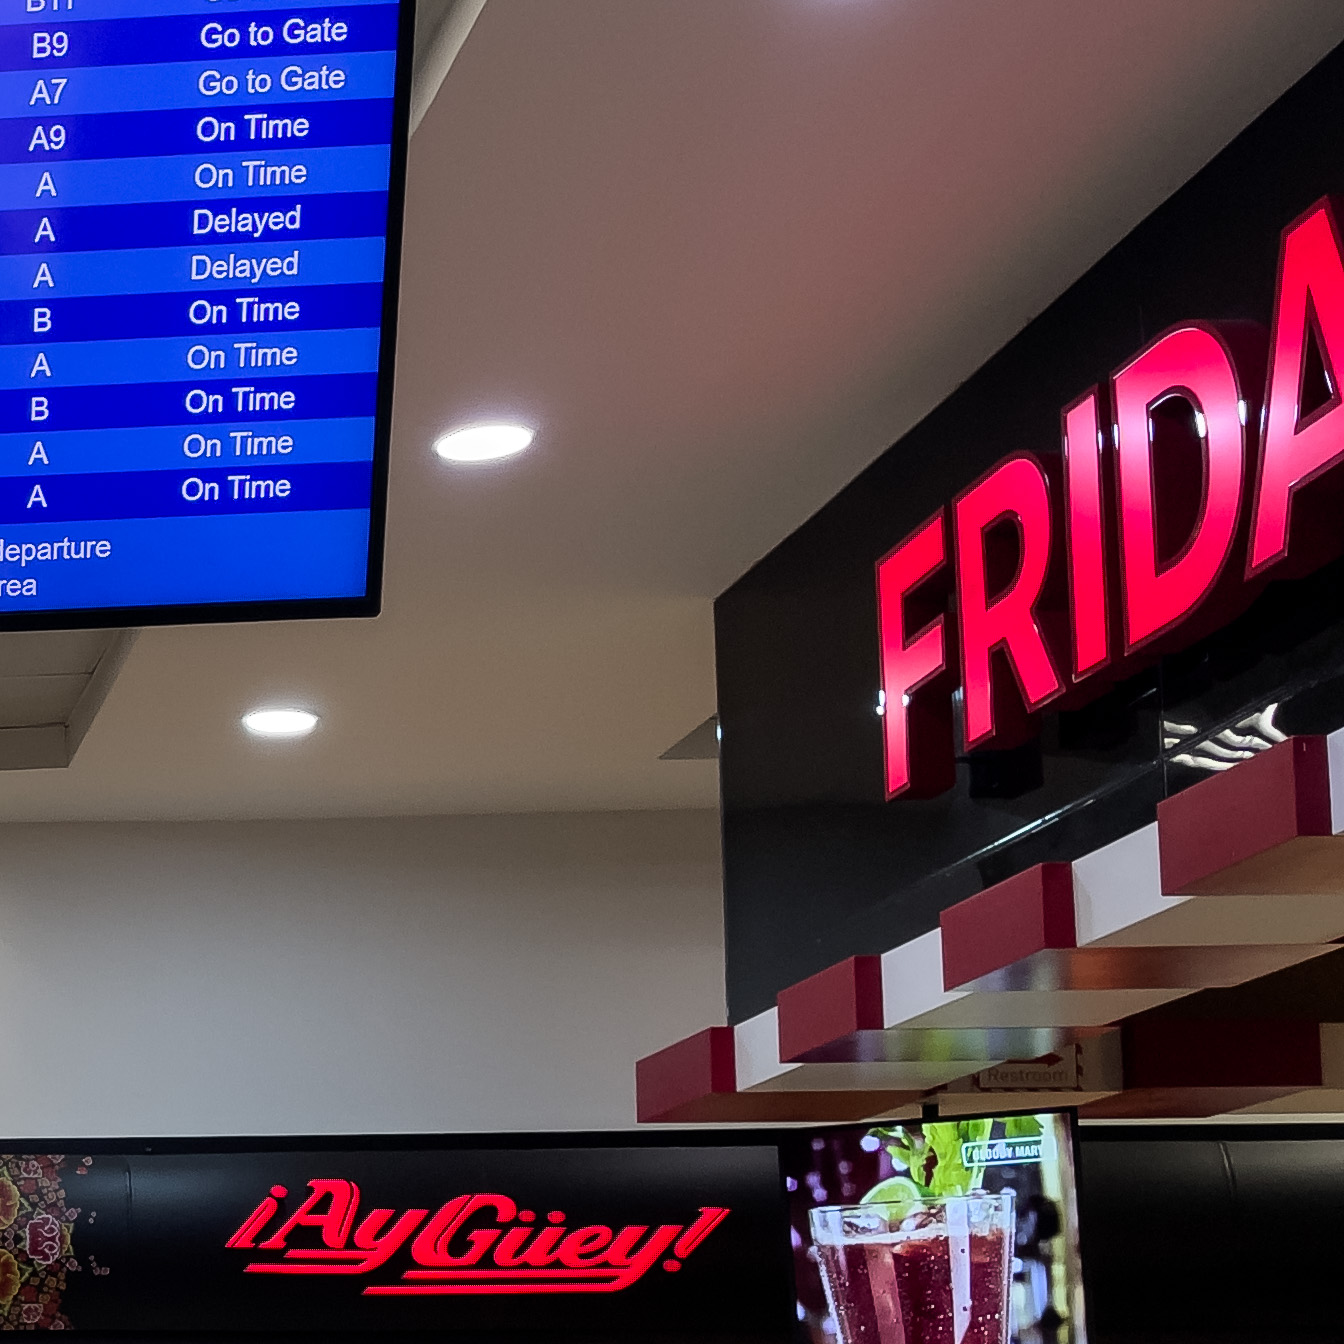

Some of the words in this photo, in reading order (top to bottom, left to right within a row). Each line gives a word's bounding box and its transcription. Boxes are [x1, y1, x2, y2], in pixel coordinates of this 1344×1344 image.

[32, 31, 69, 59] B9
[200, 22, 241, 49] Go
[248, 21, 274, 47] to
[282, 17, 348, 44] Gate
[35, 171, 57, 198] A
[194, 163, 234, 189] On
[241, 160, 307, 187] Time
[30, 352, 52, 378] A
[187, 345, 225, 370] On
[233, 342, 298, 368] Time
[30, 396, 49, 422] B
[185, 389, 224, 414] On
[231, 386, 296, 412] Time
[27, 441, 49, 466] A
[183, 433, 221, 458] On
[229, 431, 294, 456] Time
